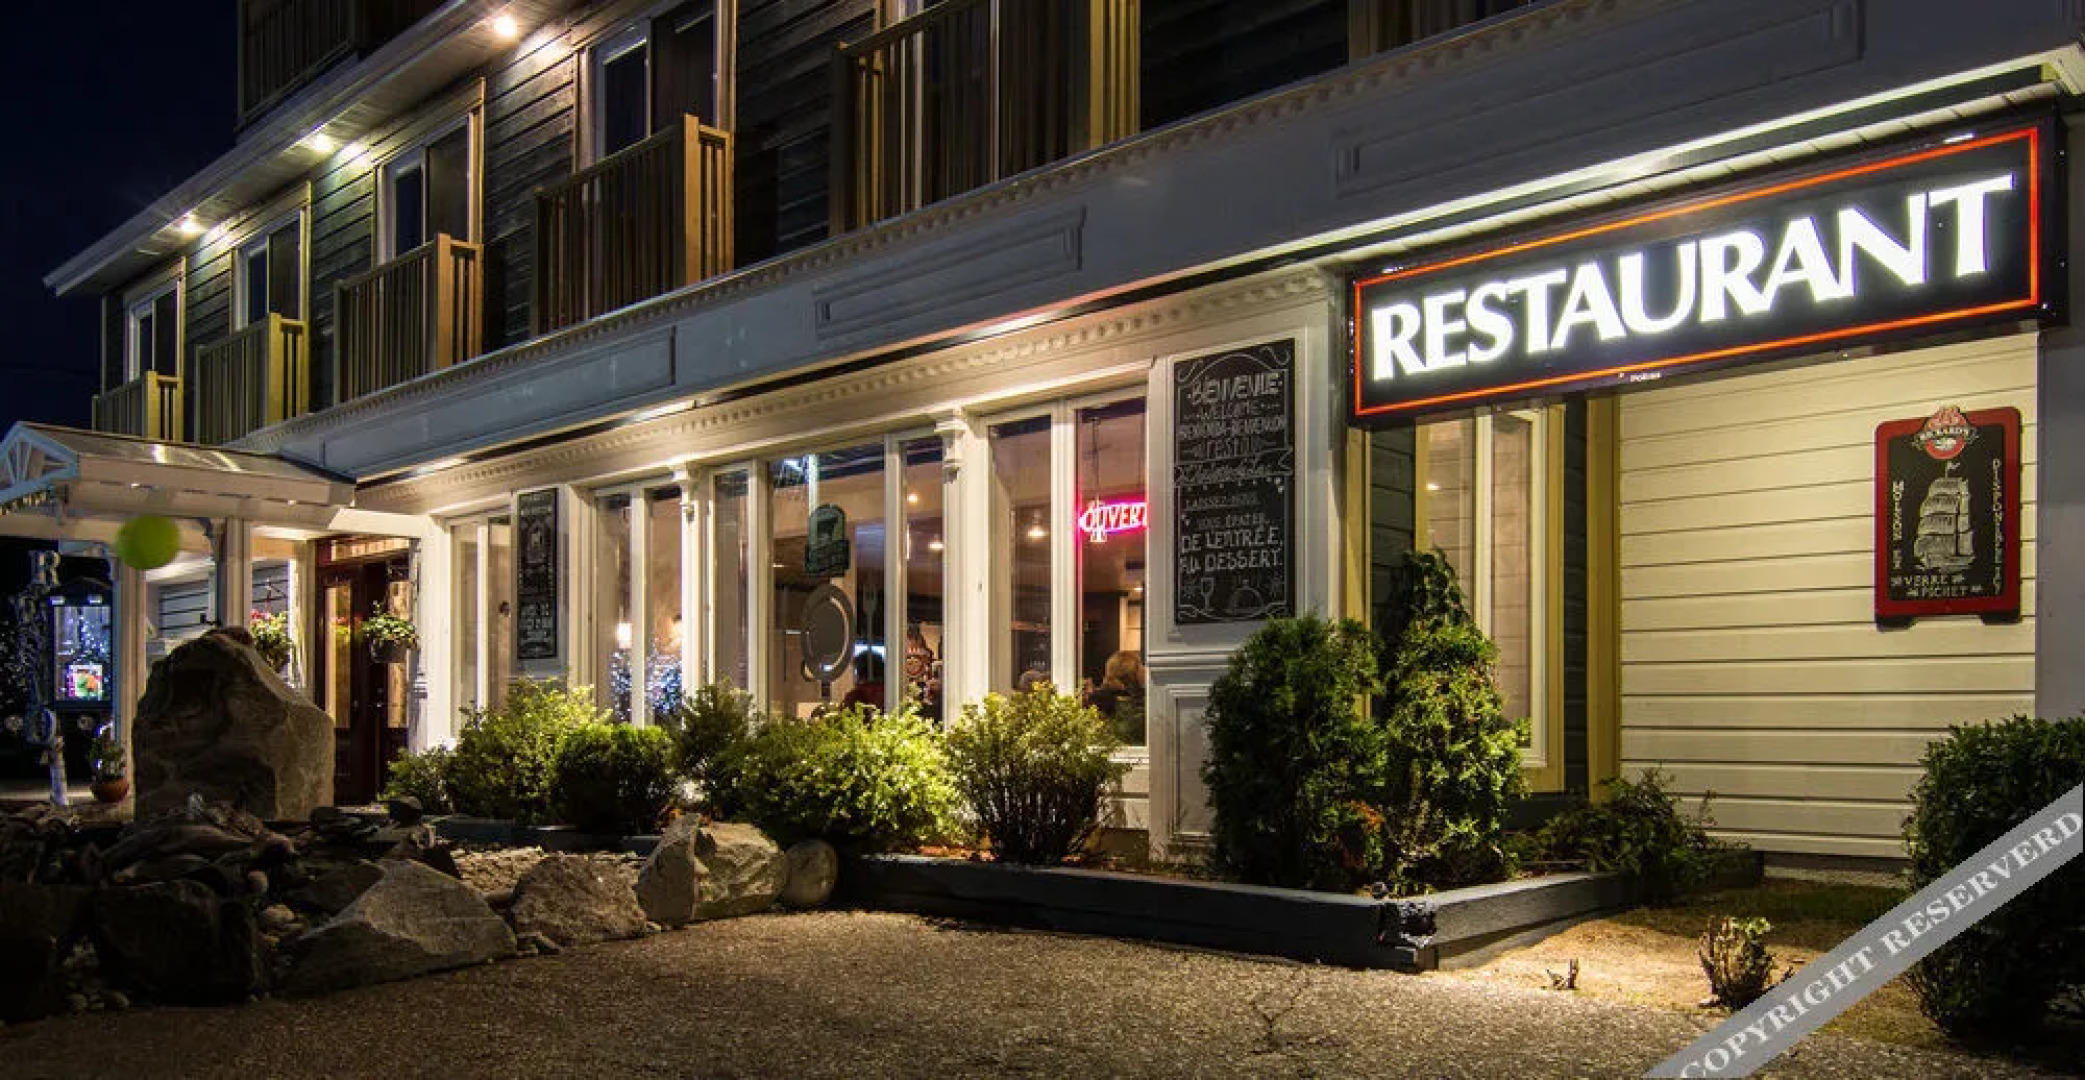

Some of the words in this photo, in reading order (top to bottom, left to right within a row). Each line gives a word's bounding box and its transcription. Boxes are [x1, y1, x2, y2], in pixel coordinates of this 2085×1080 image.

[1372, 173, 2014, 381] RESTAURANT
[1182, 533, 1201, 553] DE
[1903, 575, 1948, 586] VERRE
